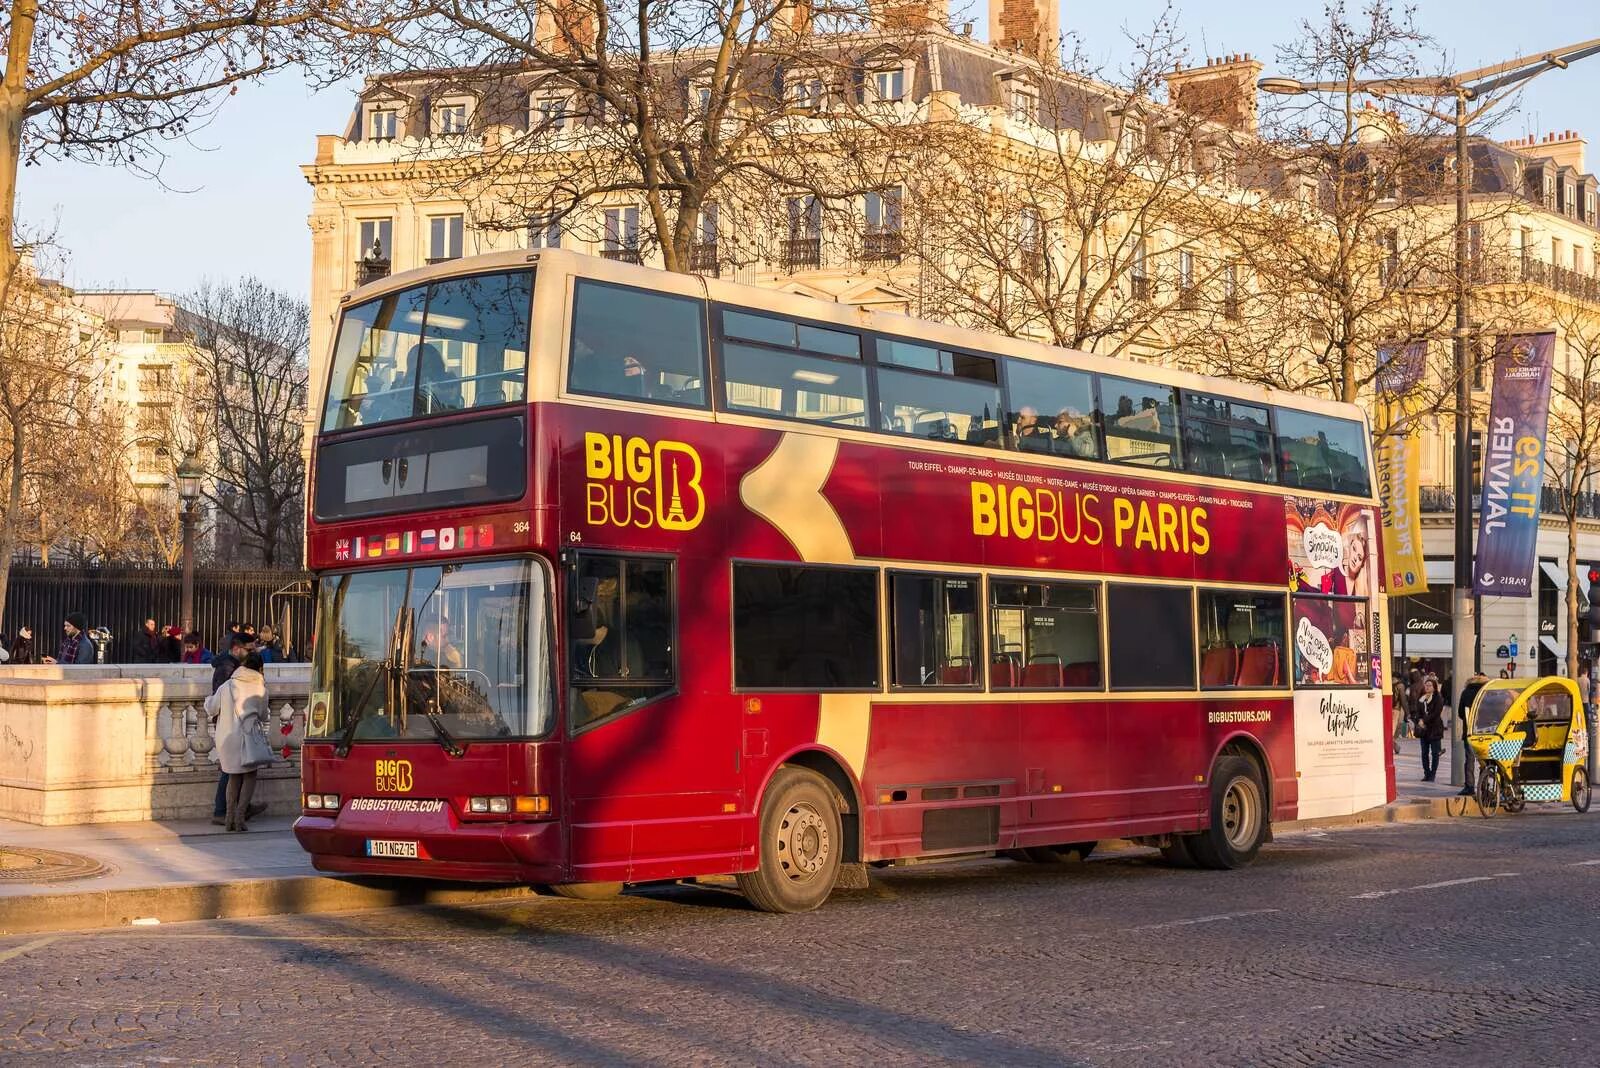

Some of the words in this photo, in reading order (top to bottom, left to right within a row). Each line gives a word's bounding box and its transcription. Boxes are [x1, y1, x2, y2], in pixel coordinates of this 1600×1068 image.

[585, 431, 652, 483] BIG
[908, 461, 923, 470] TOUR
[924, 463, 943, 472] EIFFEL
[948, 465, 993, 478] CHAMP-DE-MARS
[1015, 473, 1024, 481] DU
[1024, 474, 1043, 484] LOUVRE
[1047, 477, 1079, 489] NOTRE-DAME
[1136, 488, 1156, 497] GARNIER
[1198, 495, 1213, 504] GRAND
[1213, 498, 1228, 506] PALAIS
[586, 482, 654, 529] BUS
[513, 521, 529, 533] 364
[1114, 497, 1210, 555] PARIS
[570, 531, 582, 542] 64
[1407, 618, 1439, 629] Cartier
[1208, 710, 1271, 723] BIGBUSTOURS.COM
[375, 760, 396, 776] BIG
[376, 776, 396, 792] BUS
[351, 798, 443, 812] BIGBUSTOURS.COM
